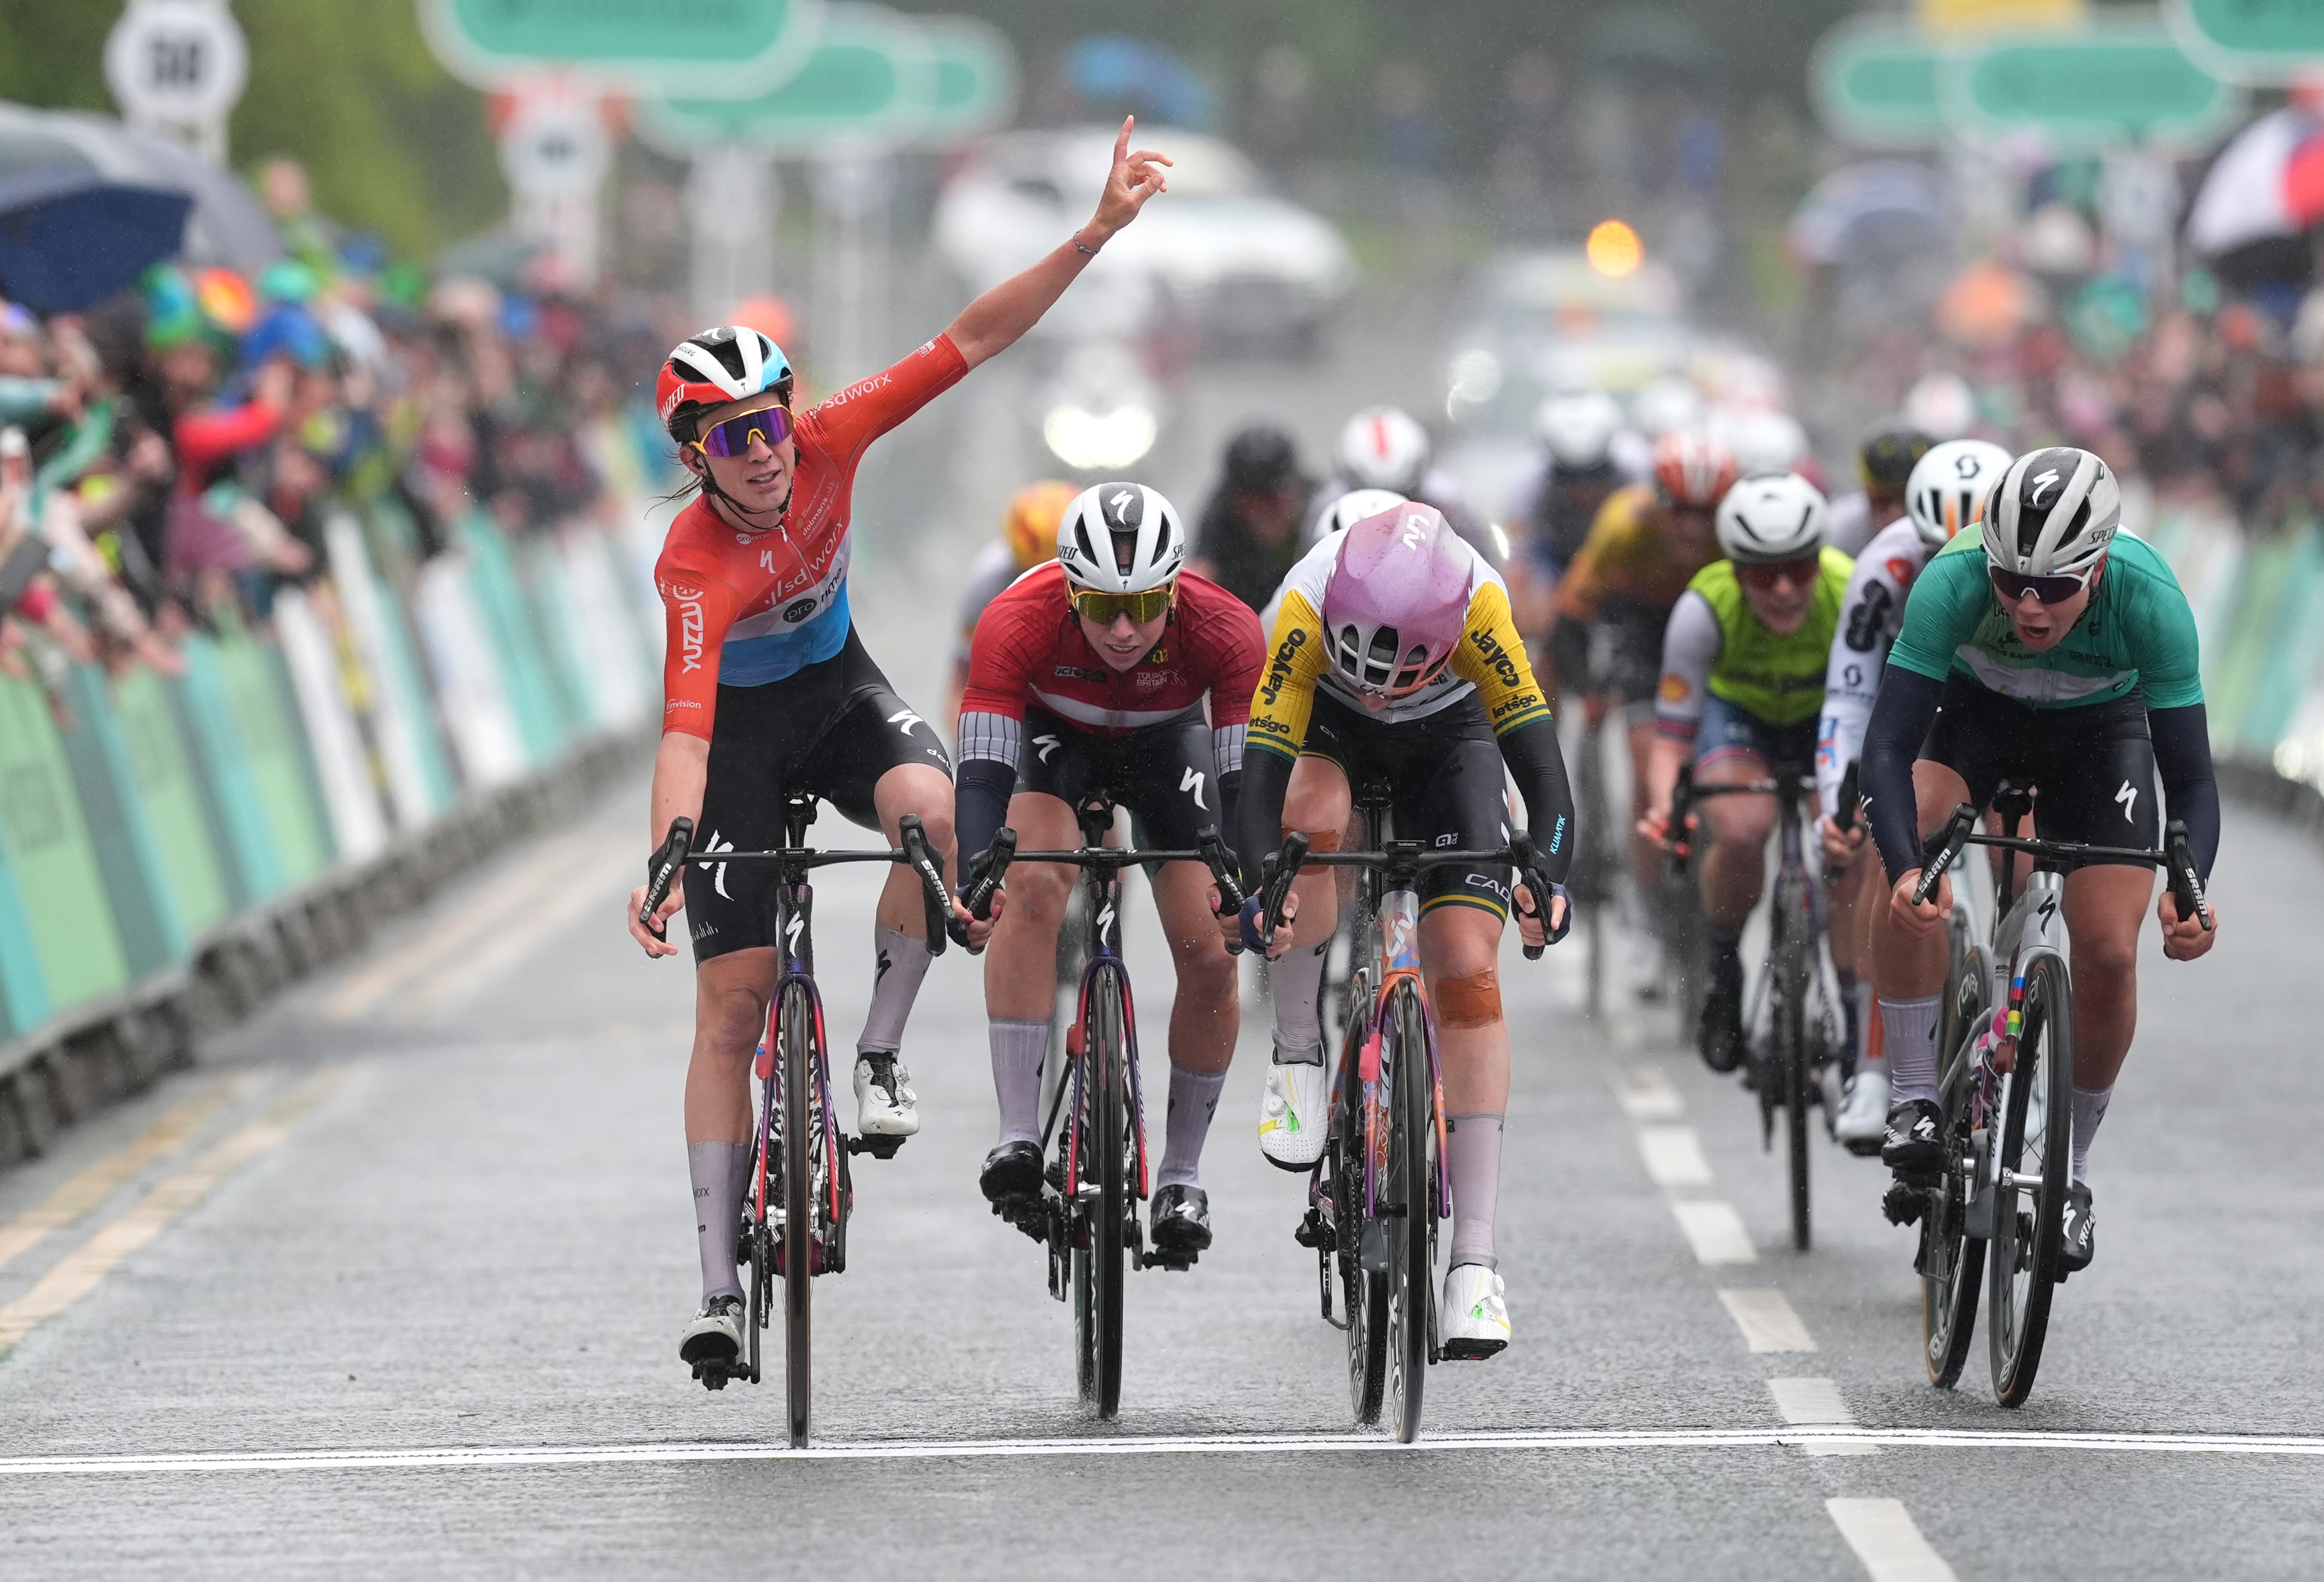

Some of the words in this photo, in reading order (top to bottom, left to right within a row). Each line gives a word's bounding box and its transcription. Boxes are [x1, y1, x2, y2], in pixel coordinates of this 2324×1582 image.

[826, 373, 892, 409] sdworx
[803, 496, 828, 536] dolmans
[1261, 628, 1307, 706] Jayco
[1470, 628, 1520, 687] Jayco
[1136, 676, 1167, 686] BRITAIN
[926, 748, 952, 772] dol
[1549, 813, 1566, 855] KLIMATIK
[644, 862, 672, 912] SRAM
[920, 859, 951, 907] SRAM
[1918, 848, 1951, 893] SRAM
[2185, 868, 2208, 916] SRAM
[969, 877, 993, 910] RAM
